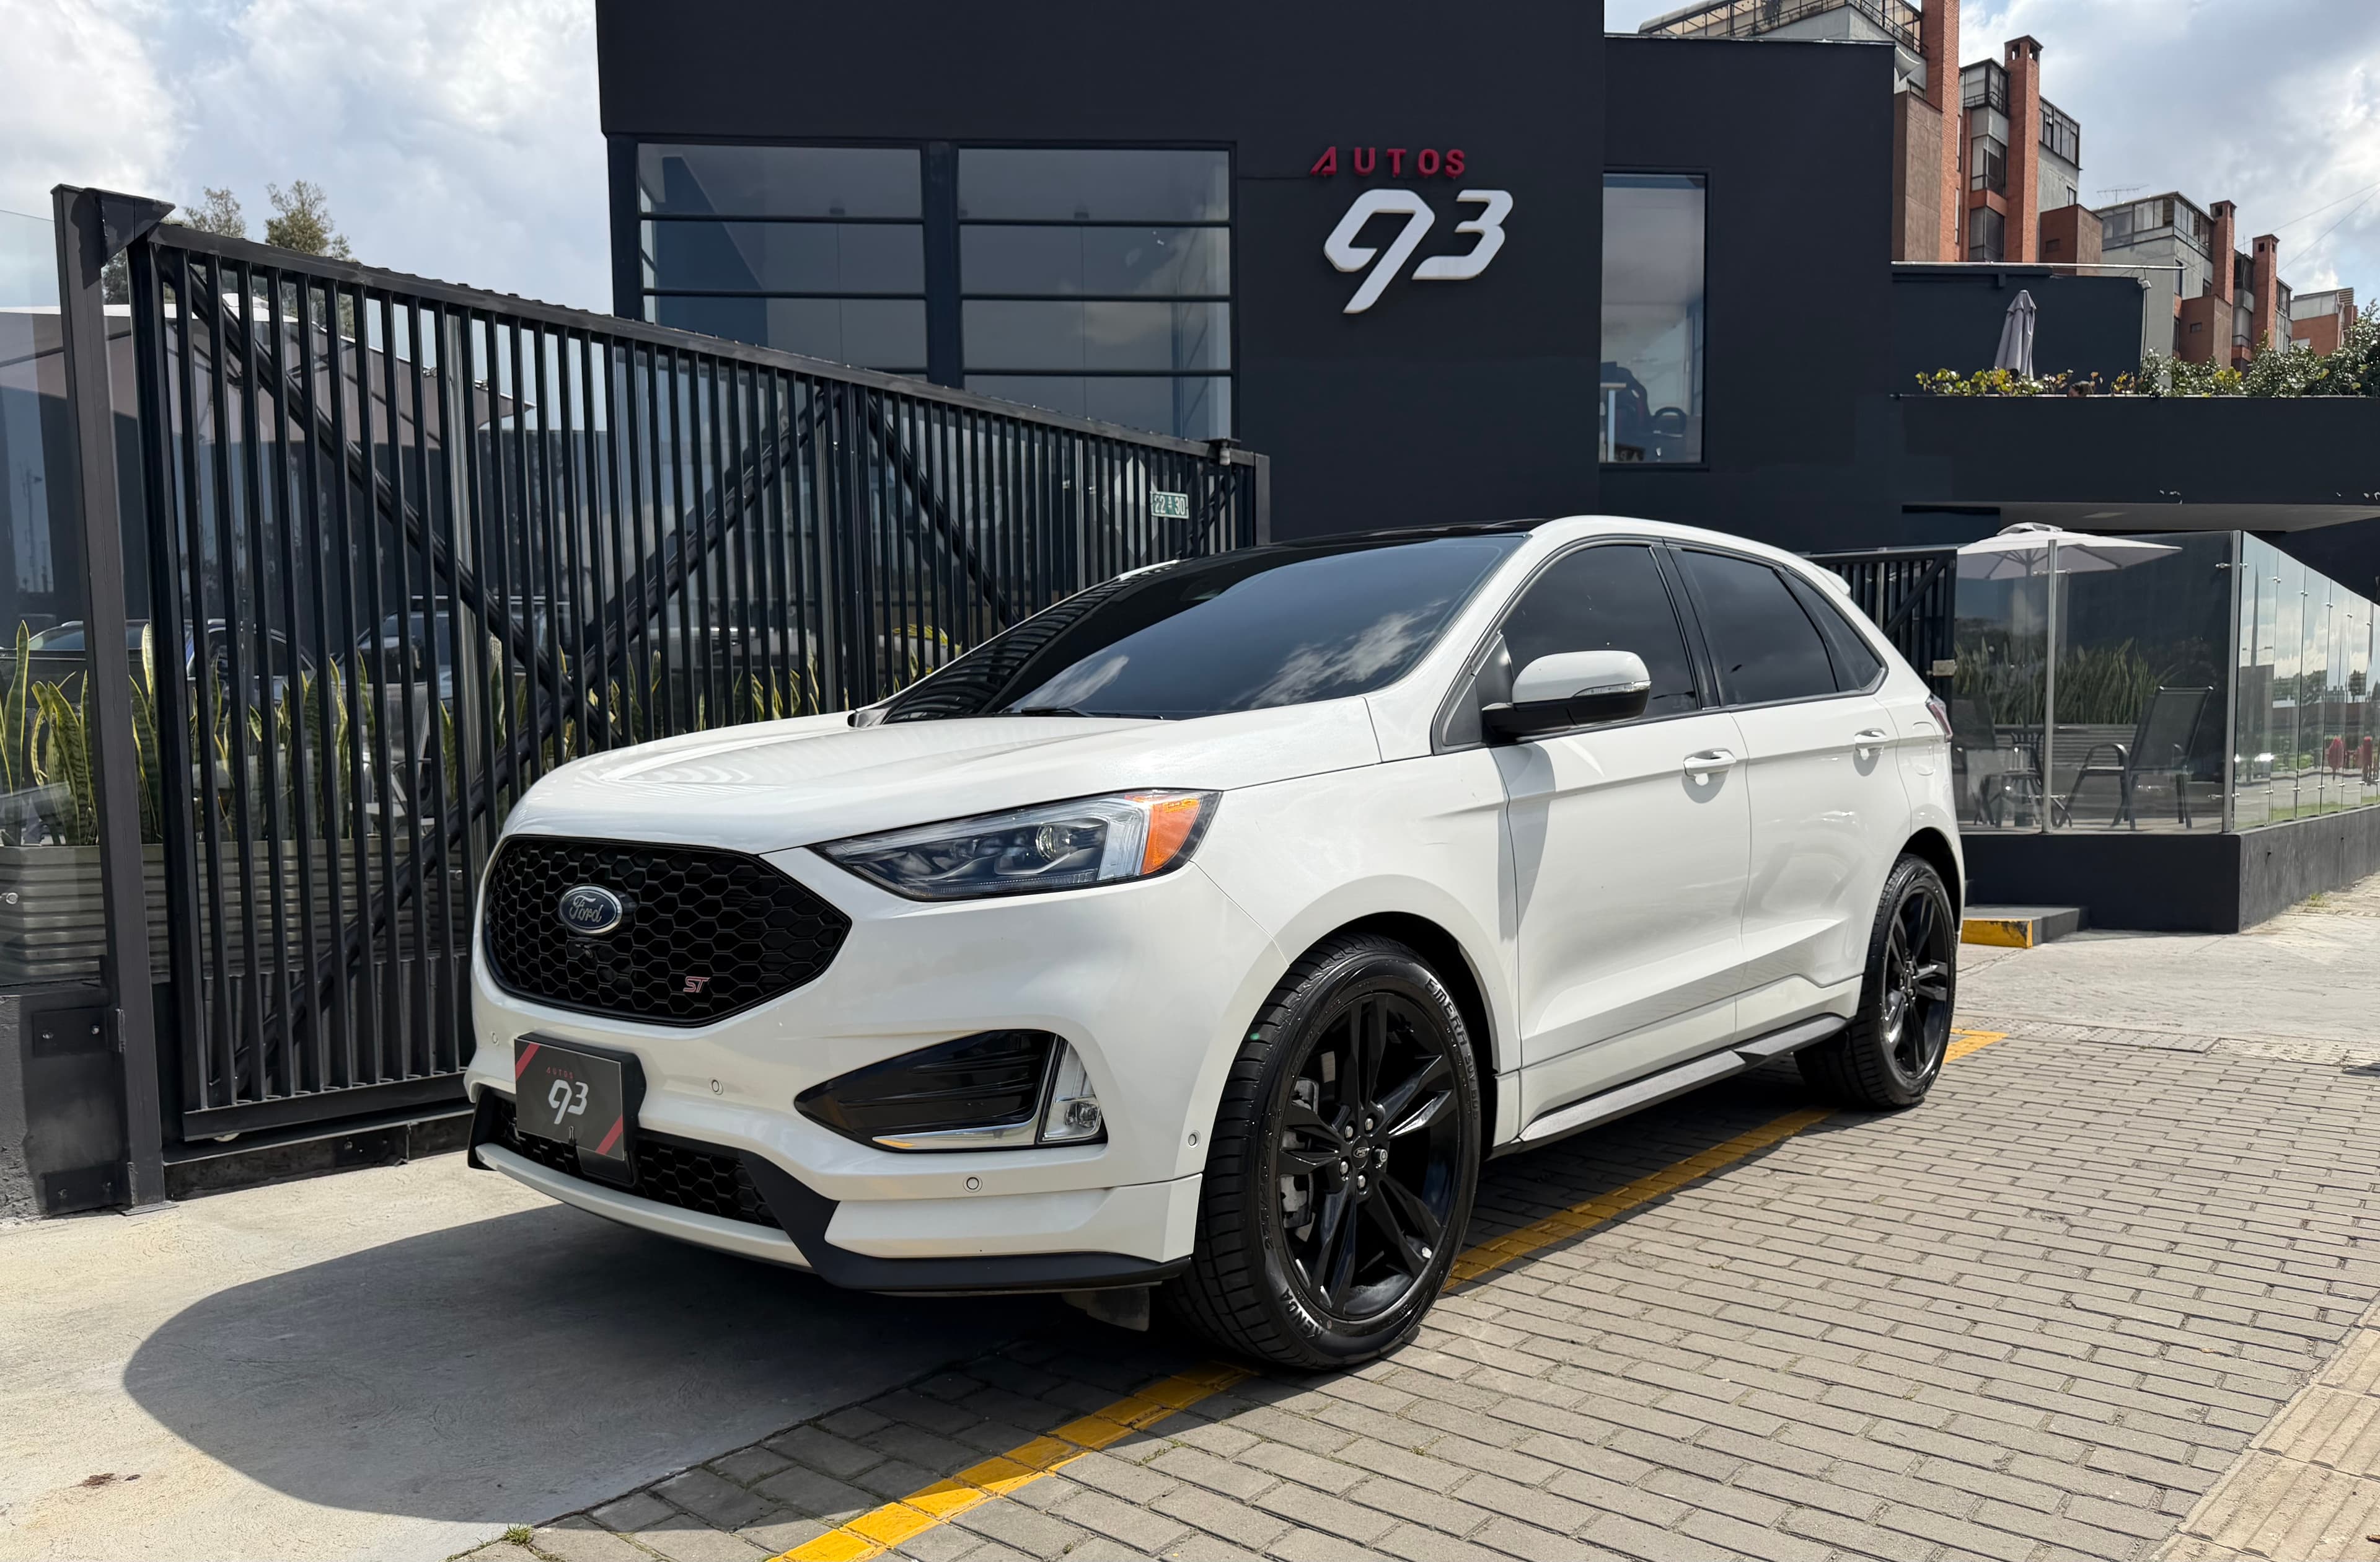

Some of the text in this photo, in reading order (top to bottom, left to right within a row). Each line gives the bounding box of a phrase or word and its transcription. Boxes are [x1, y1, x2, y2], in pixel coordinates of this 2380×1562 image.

[1310, 146, 1465, 177] AUTOS
[1324, 188, 1514, 314] 93
[569, 895, 604, 923] Ford
[683, 976, 711, 993] ST
[1426, 977, 1468, 1045] EMERA
[546, 1066, 574, 1080] AUTOS
[549, 1079, 589, 1124] 93
[1279, 1287, 1323, 1339] KENDA
